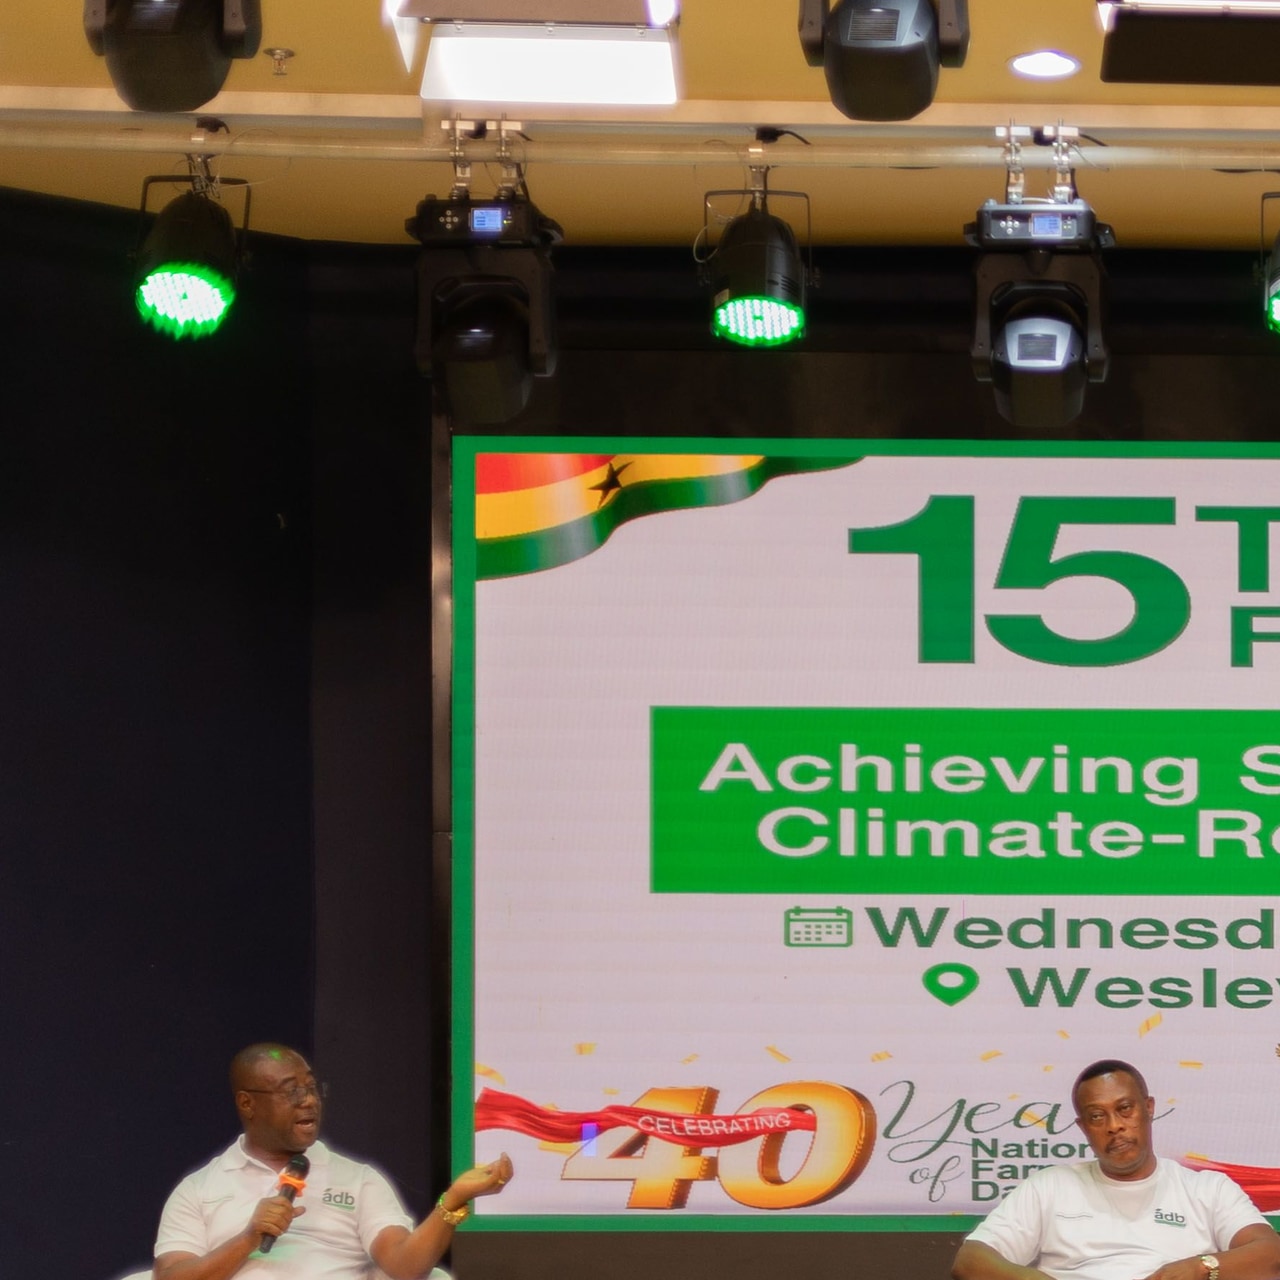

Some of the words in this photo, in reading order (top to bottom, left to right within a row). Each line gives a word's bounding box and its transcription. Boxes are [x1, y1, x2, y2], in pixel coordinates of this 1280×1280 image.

[699, 742, 1199, 804] Achieving
[561, 1079, 876, 1210] 40
[637, 1112, 792, 1137] CELEBRATING
[880, 1080, 1175, 1163] Yea
[909, 1155, 965, 1203] of
[972, 1138, 1099, 1159] Nation
